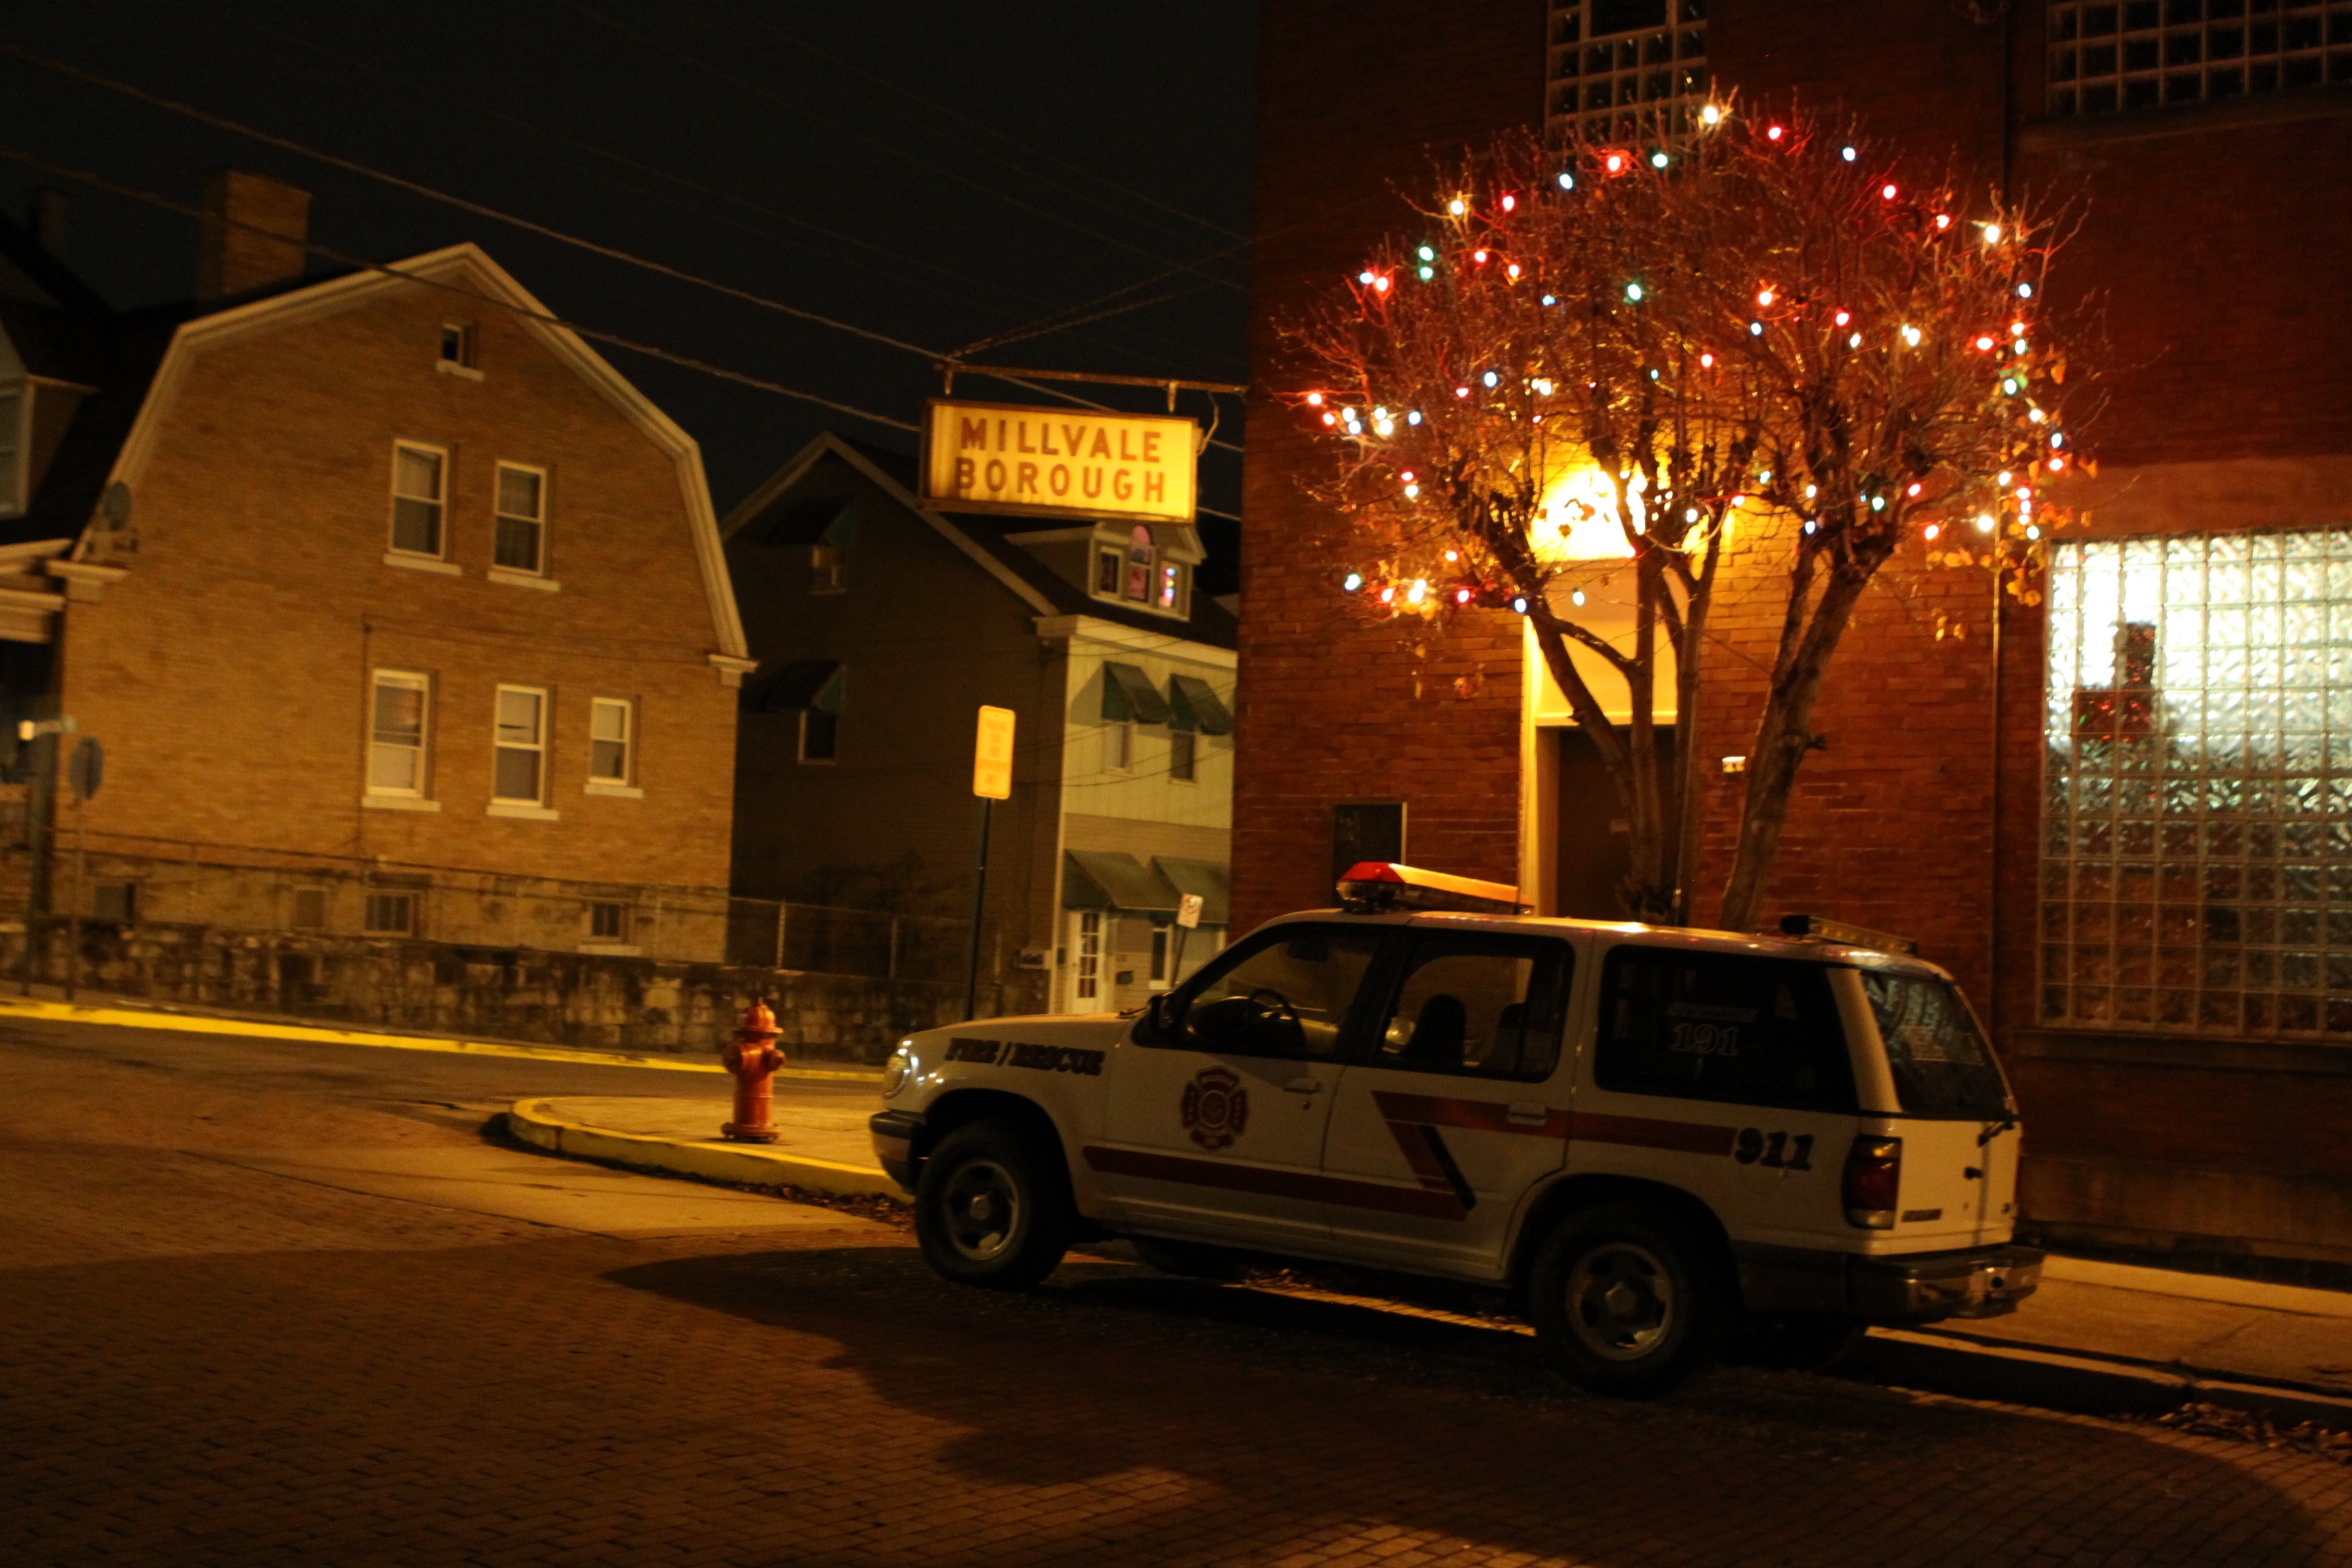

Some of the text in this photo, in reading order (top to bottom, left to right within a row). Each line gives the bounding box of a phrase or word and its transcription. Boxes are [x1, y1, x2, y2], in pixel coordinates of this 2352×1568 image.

[960, 416, 1162, 464] MILLVALE
[955, 456, 1165, 504] BOROUGH
[1670, 1022, 1740, 1057] 191
[1734, 1127, 1814, 1171] 911
